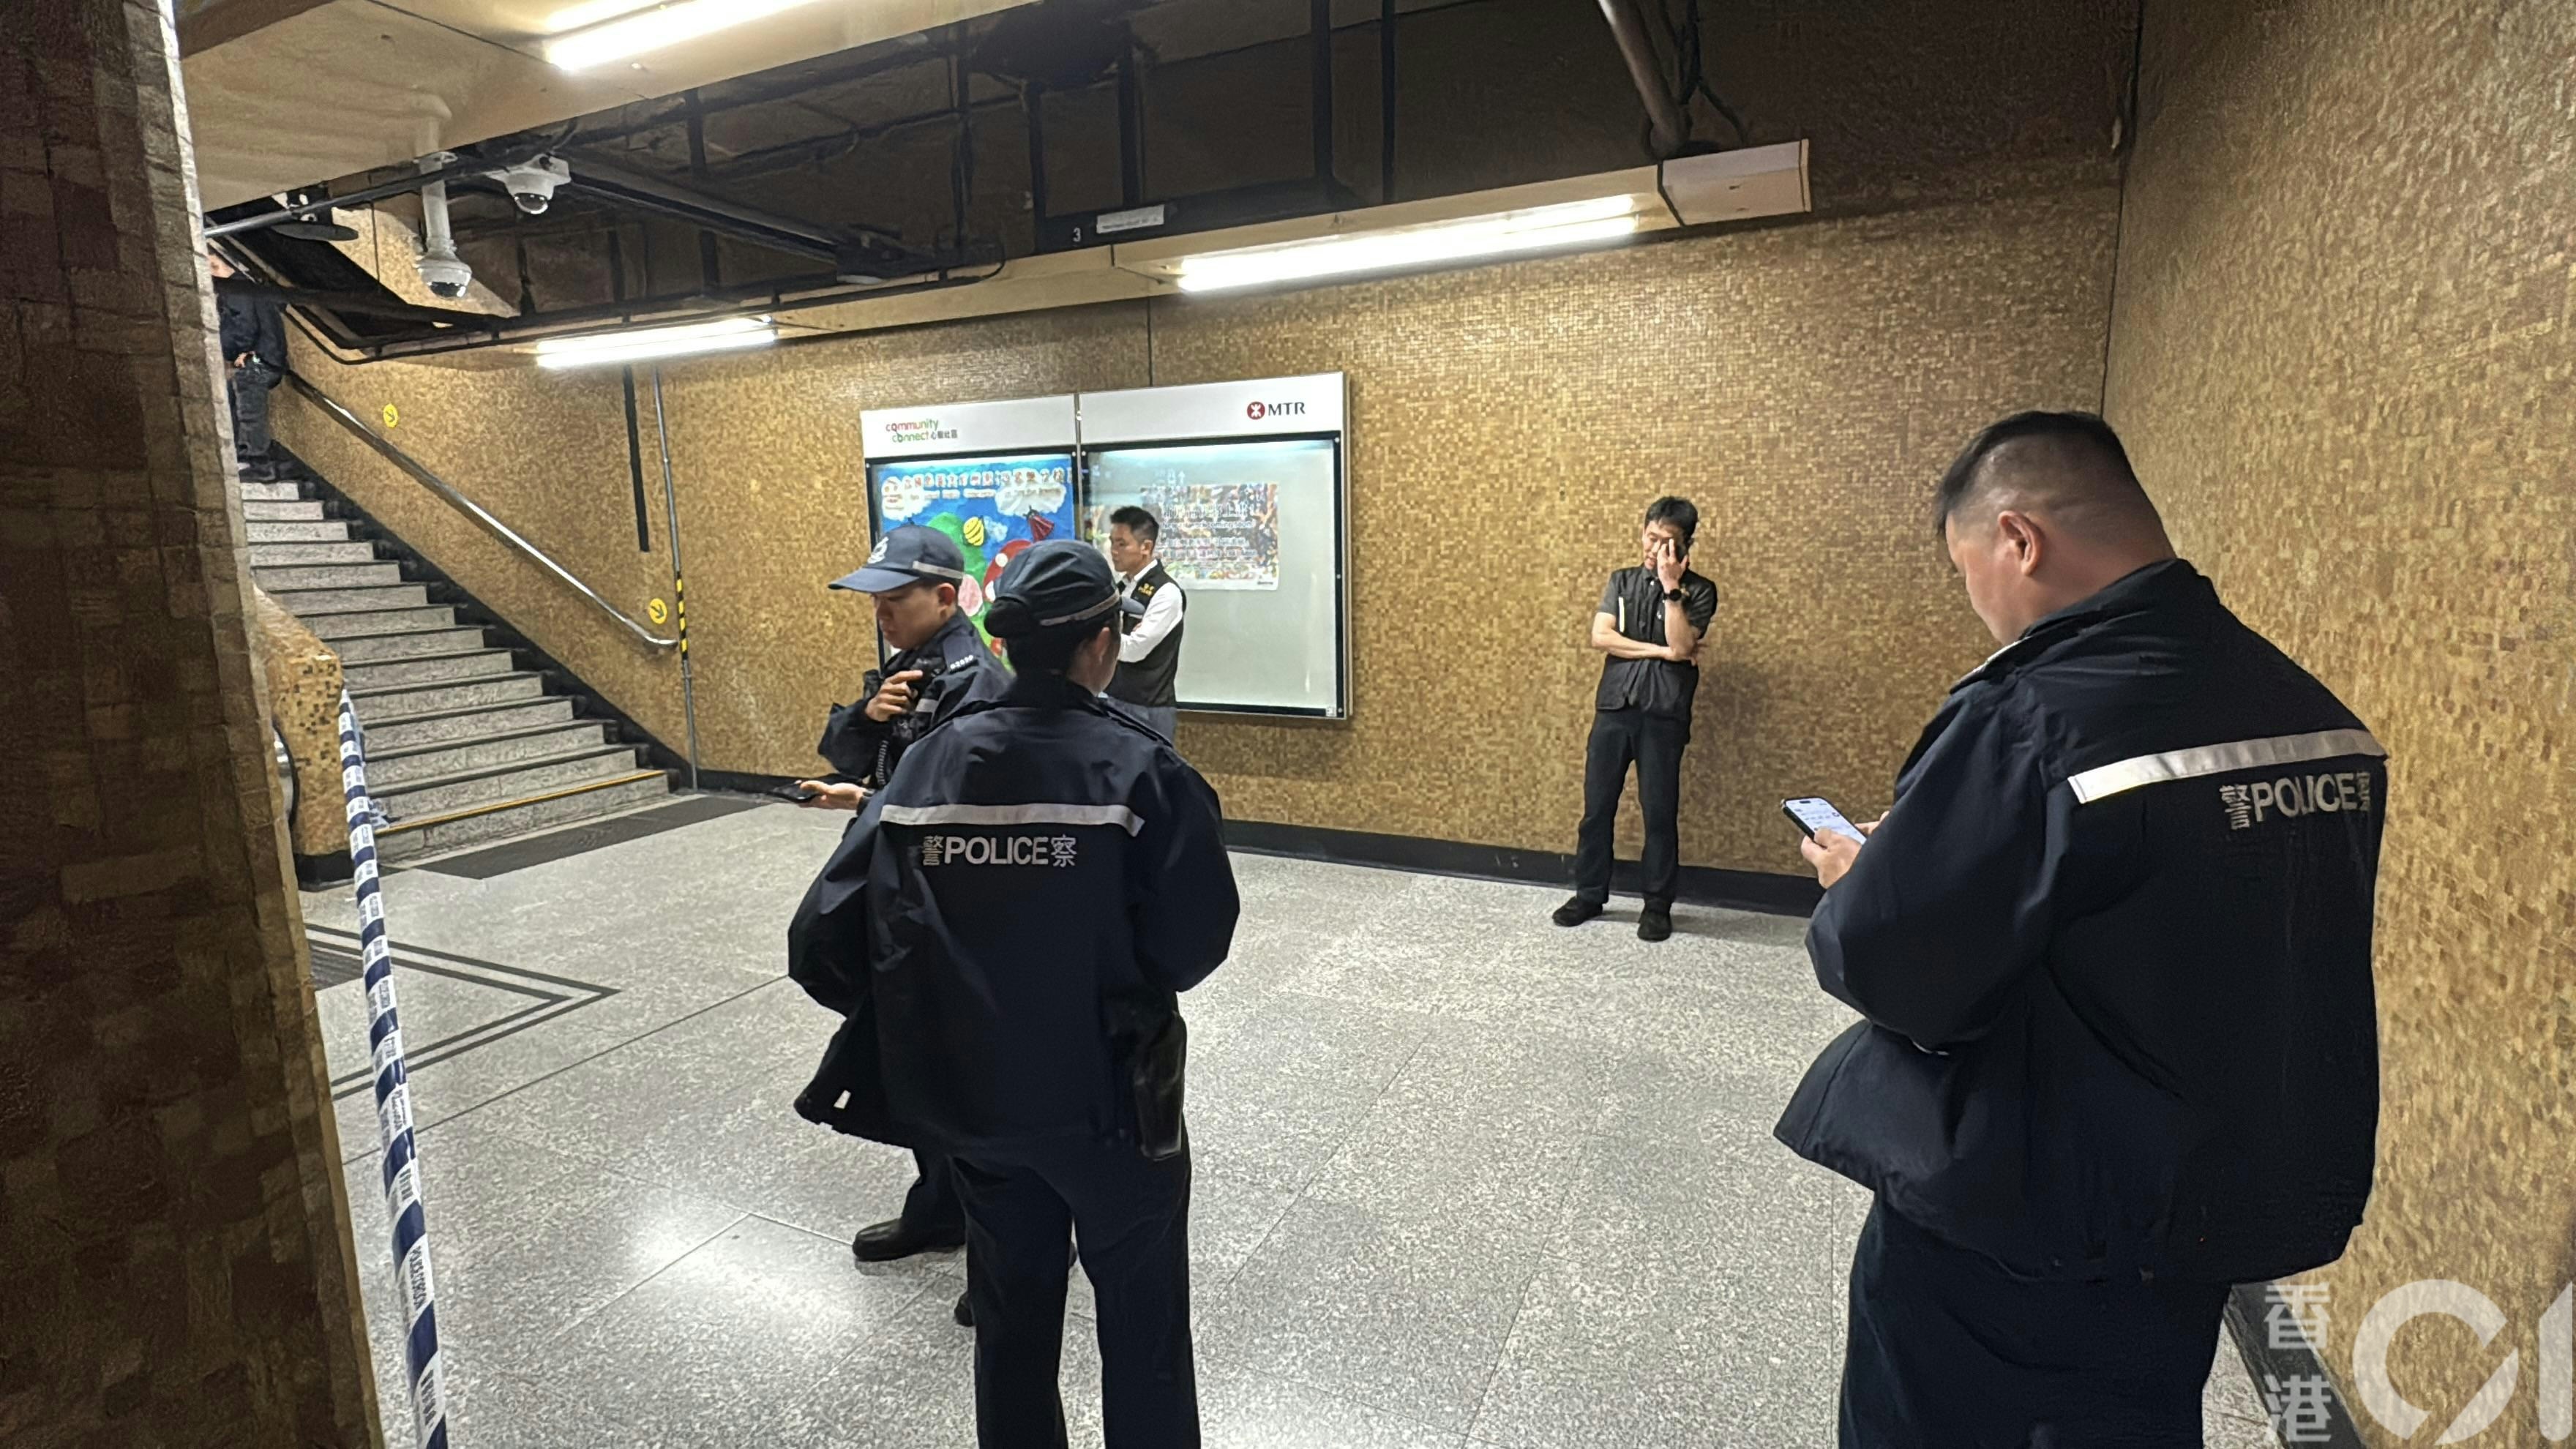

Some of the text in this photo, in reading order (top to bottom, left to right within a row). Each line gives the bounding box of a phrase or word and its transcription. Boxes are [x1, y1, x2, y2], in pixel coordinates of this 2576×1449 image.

[1073, 227, 1081, 242] 3
[1268, 401, 1306, 416] MTR
[886, 419, 939, 432] community
[892, 431, 929, 443] connect
